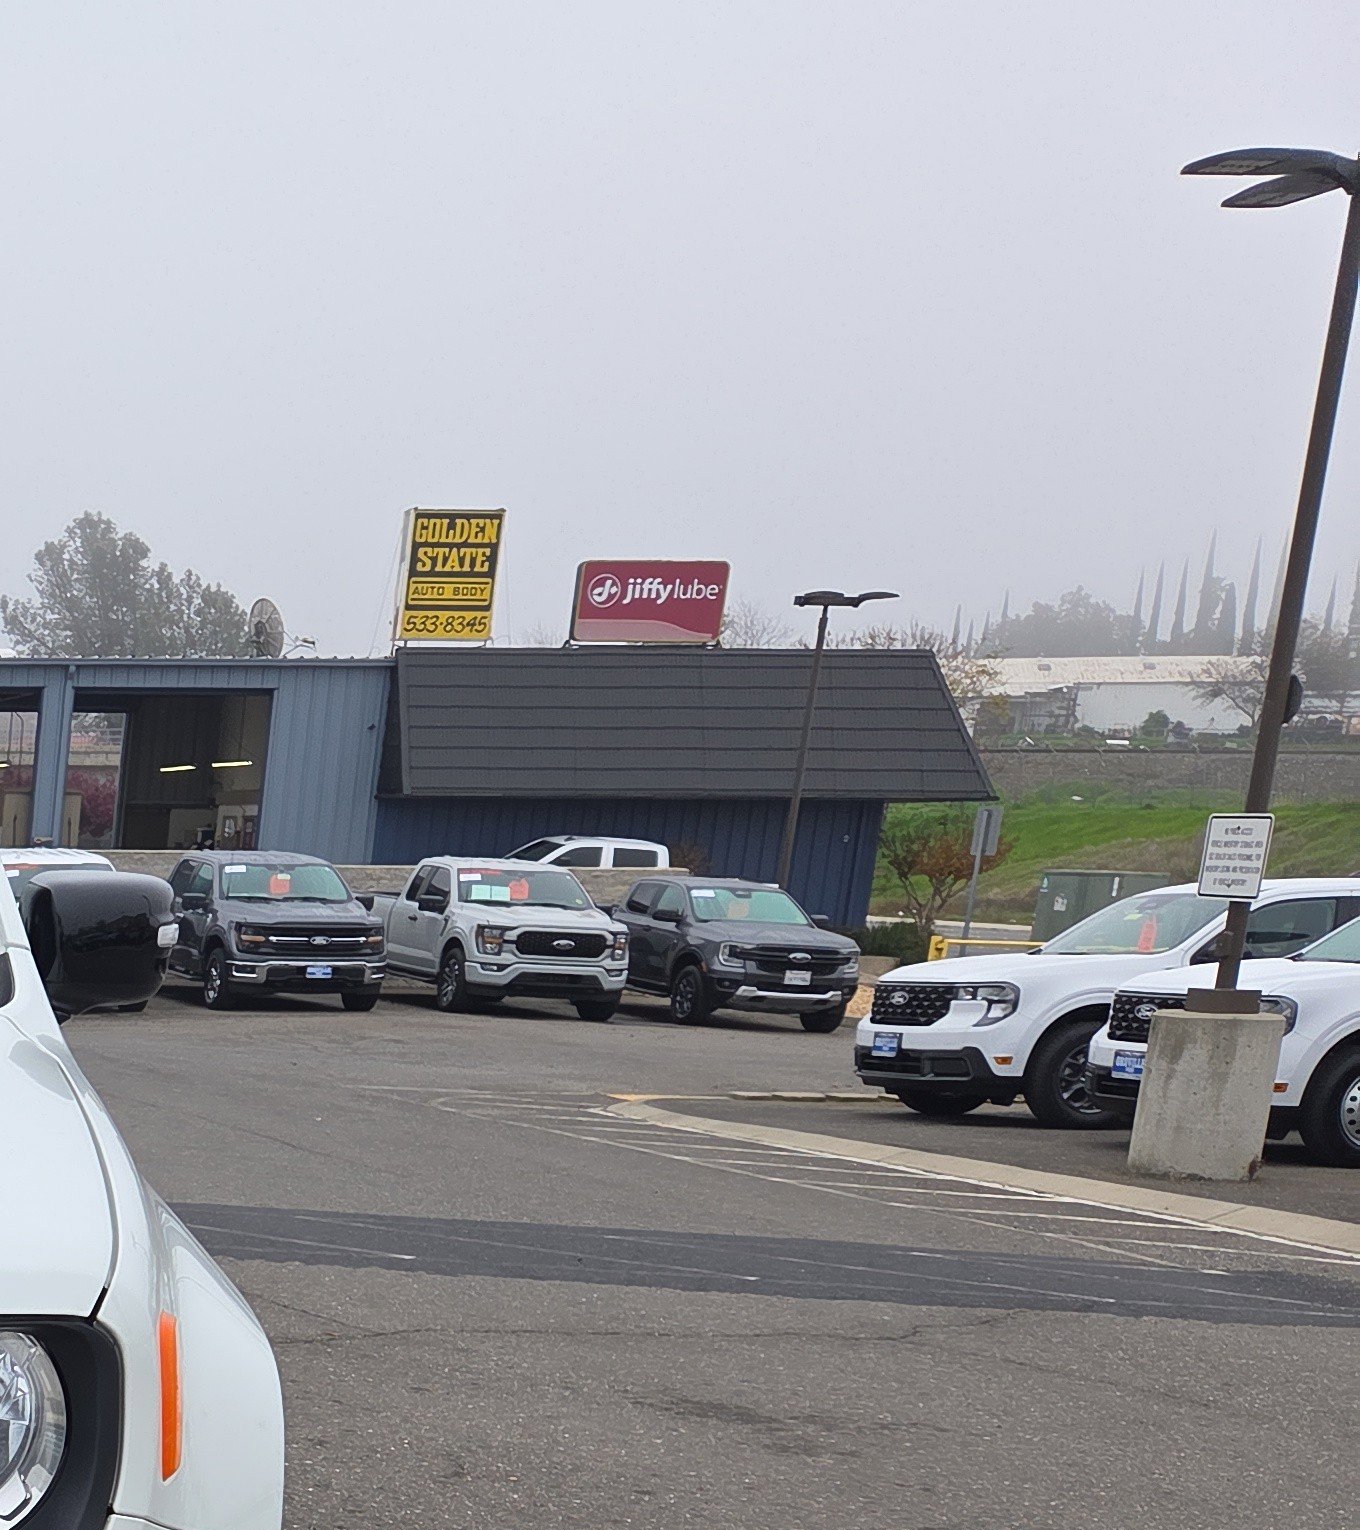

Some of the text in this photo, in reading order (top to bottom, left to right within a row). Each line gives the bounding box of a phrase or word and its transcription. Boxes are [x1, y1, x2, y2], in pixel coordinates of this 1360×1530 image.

[414, 518, 500, 543] GOLDEN
[416, 547, 491, 572] STATE
[411, 585, 487, 597] AUTO BODY
